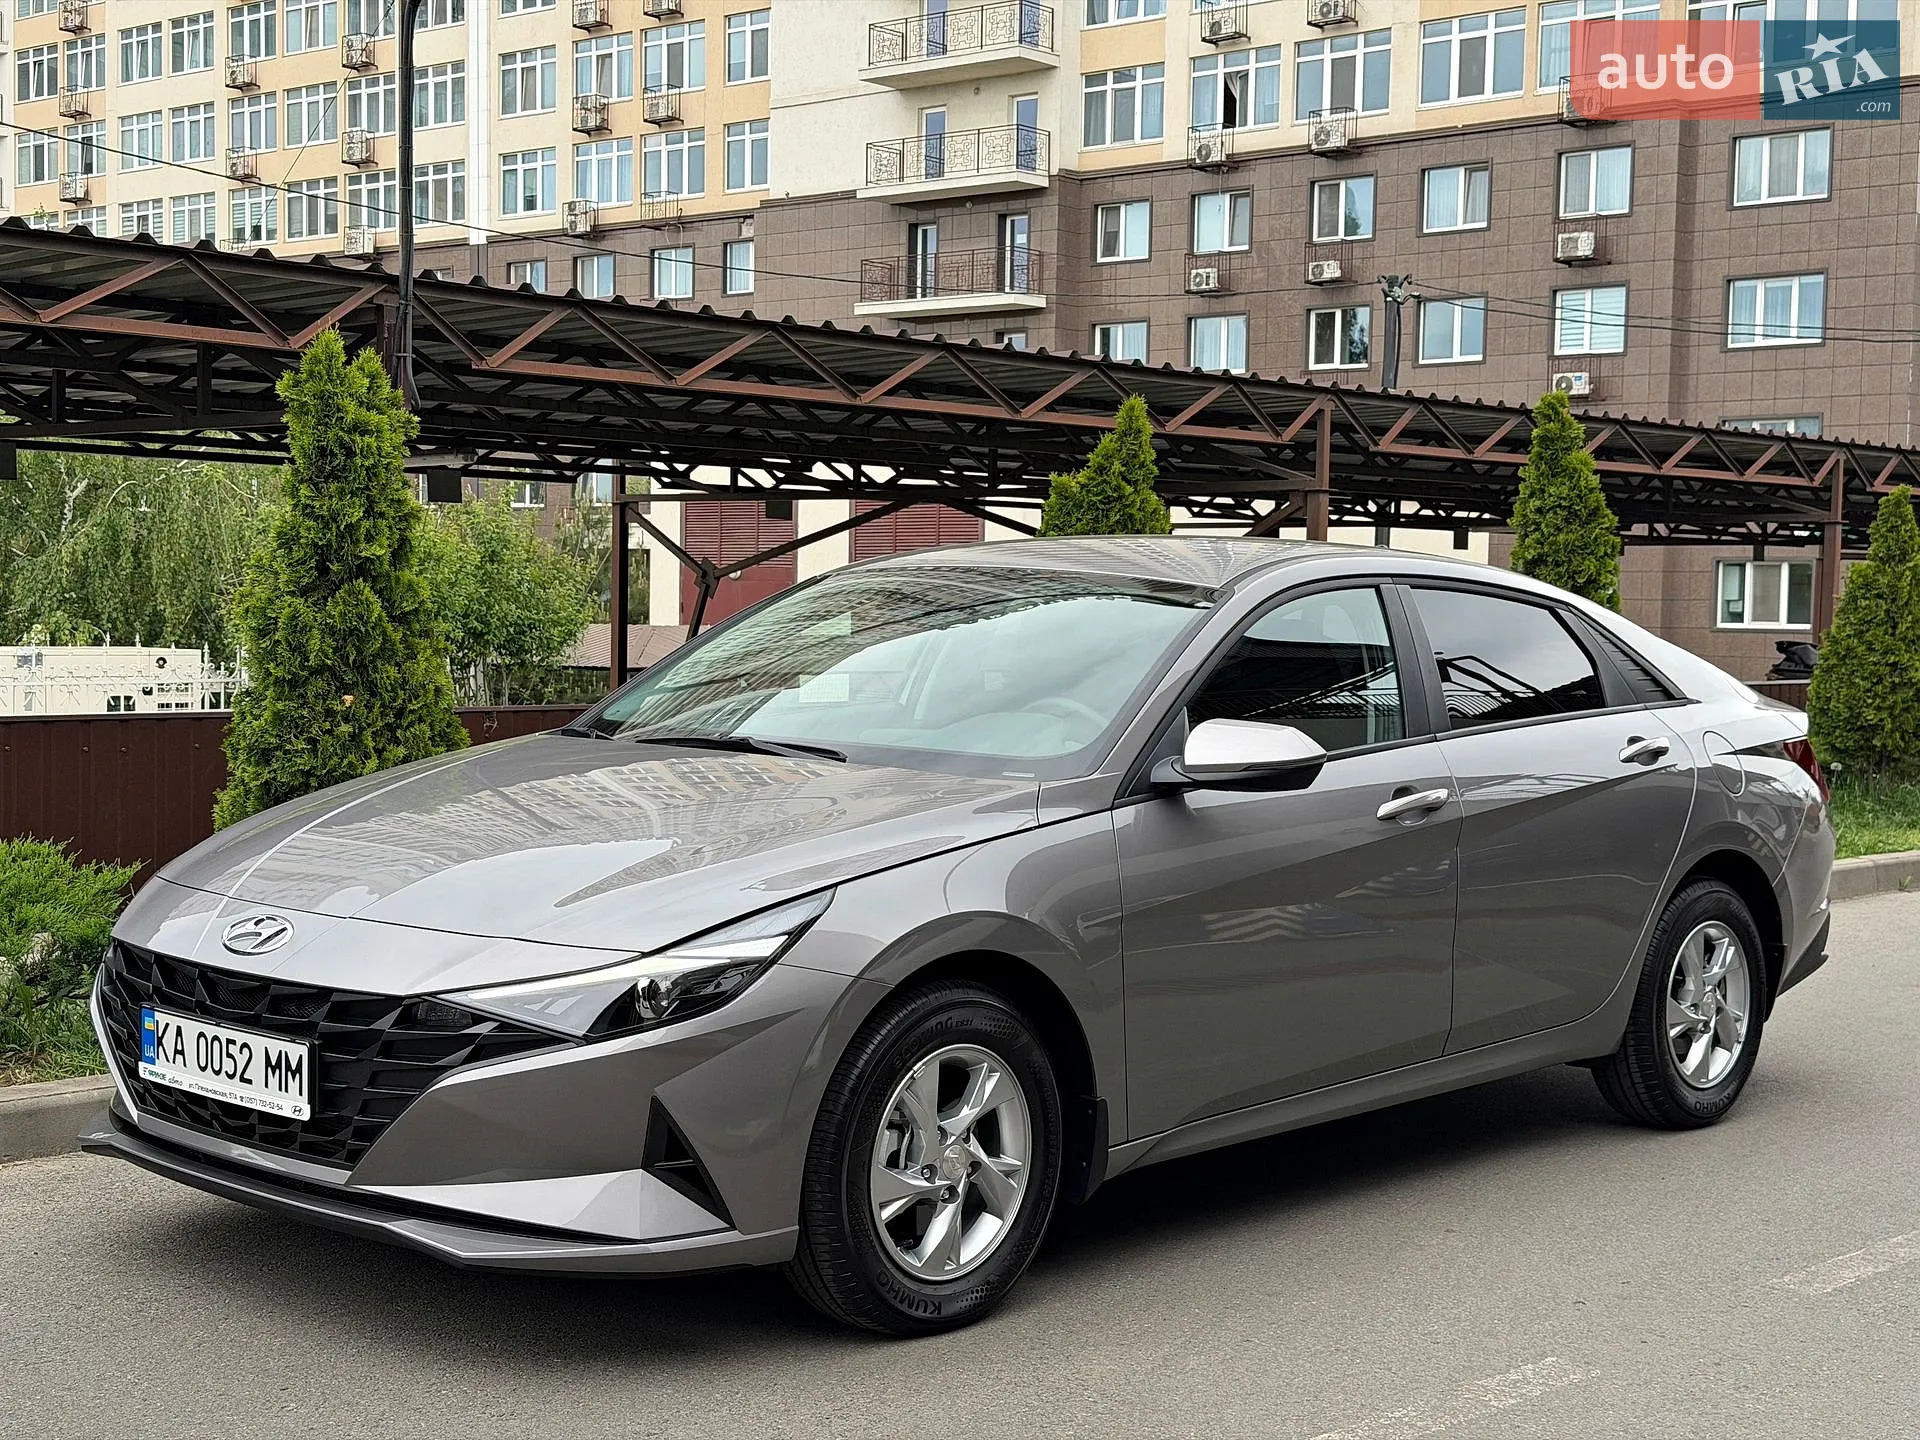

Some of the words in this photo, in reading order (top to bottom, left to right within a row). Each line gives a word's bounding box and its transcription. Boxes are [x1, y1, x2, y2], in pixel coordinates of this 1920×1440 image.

[144, 1044, 155, 1058] UA
[155, 1018, 187, 1068] KA
[196, 1031, 253, 1085] 0052
[264, 1046, 303, 1097] MM
[876, 1269, 943, 1316] KUMHO
